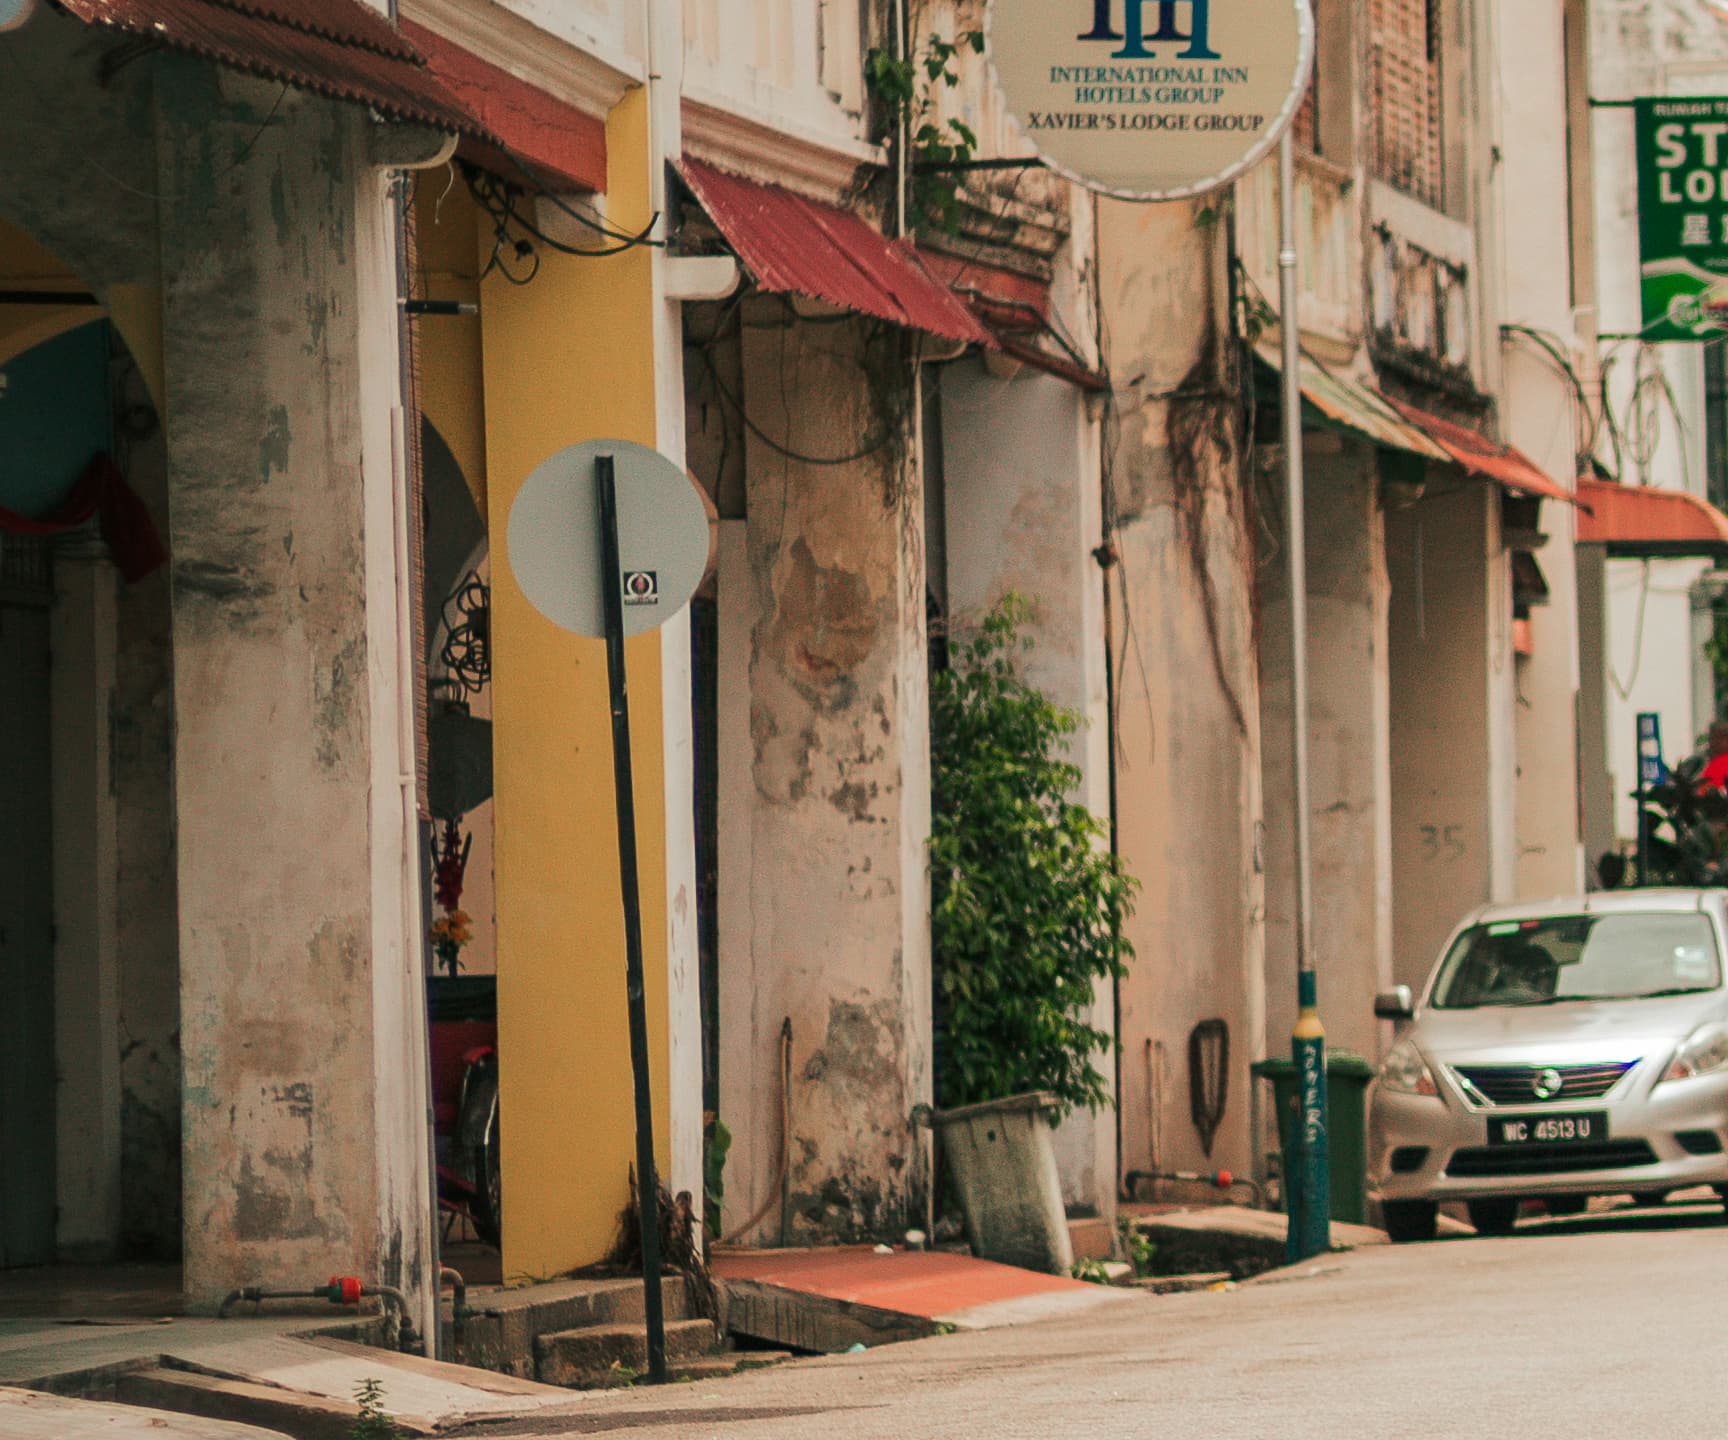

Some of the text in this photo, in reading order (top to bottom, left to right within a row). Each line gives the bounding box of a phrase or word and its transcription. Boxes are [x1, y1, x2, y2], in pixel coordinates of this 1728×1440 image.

[1049, 66, 1249, 84] INTERNATIONAL INN
[1074, 87, 1225, 104] HOTELS GROUP
[1028, 112, 1264, 131] XAVIER'S LODGE GROUP
[1503, 1122, 1528, 1142] WC
[1535, 1119, 1576, 1140] 4513
